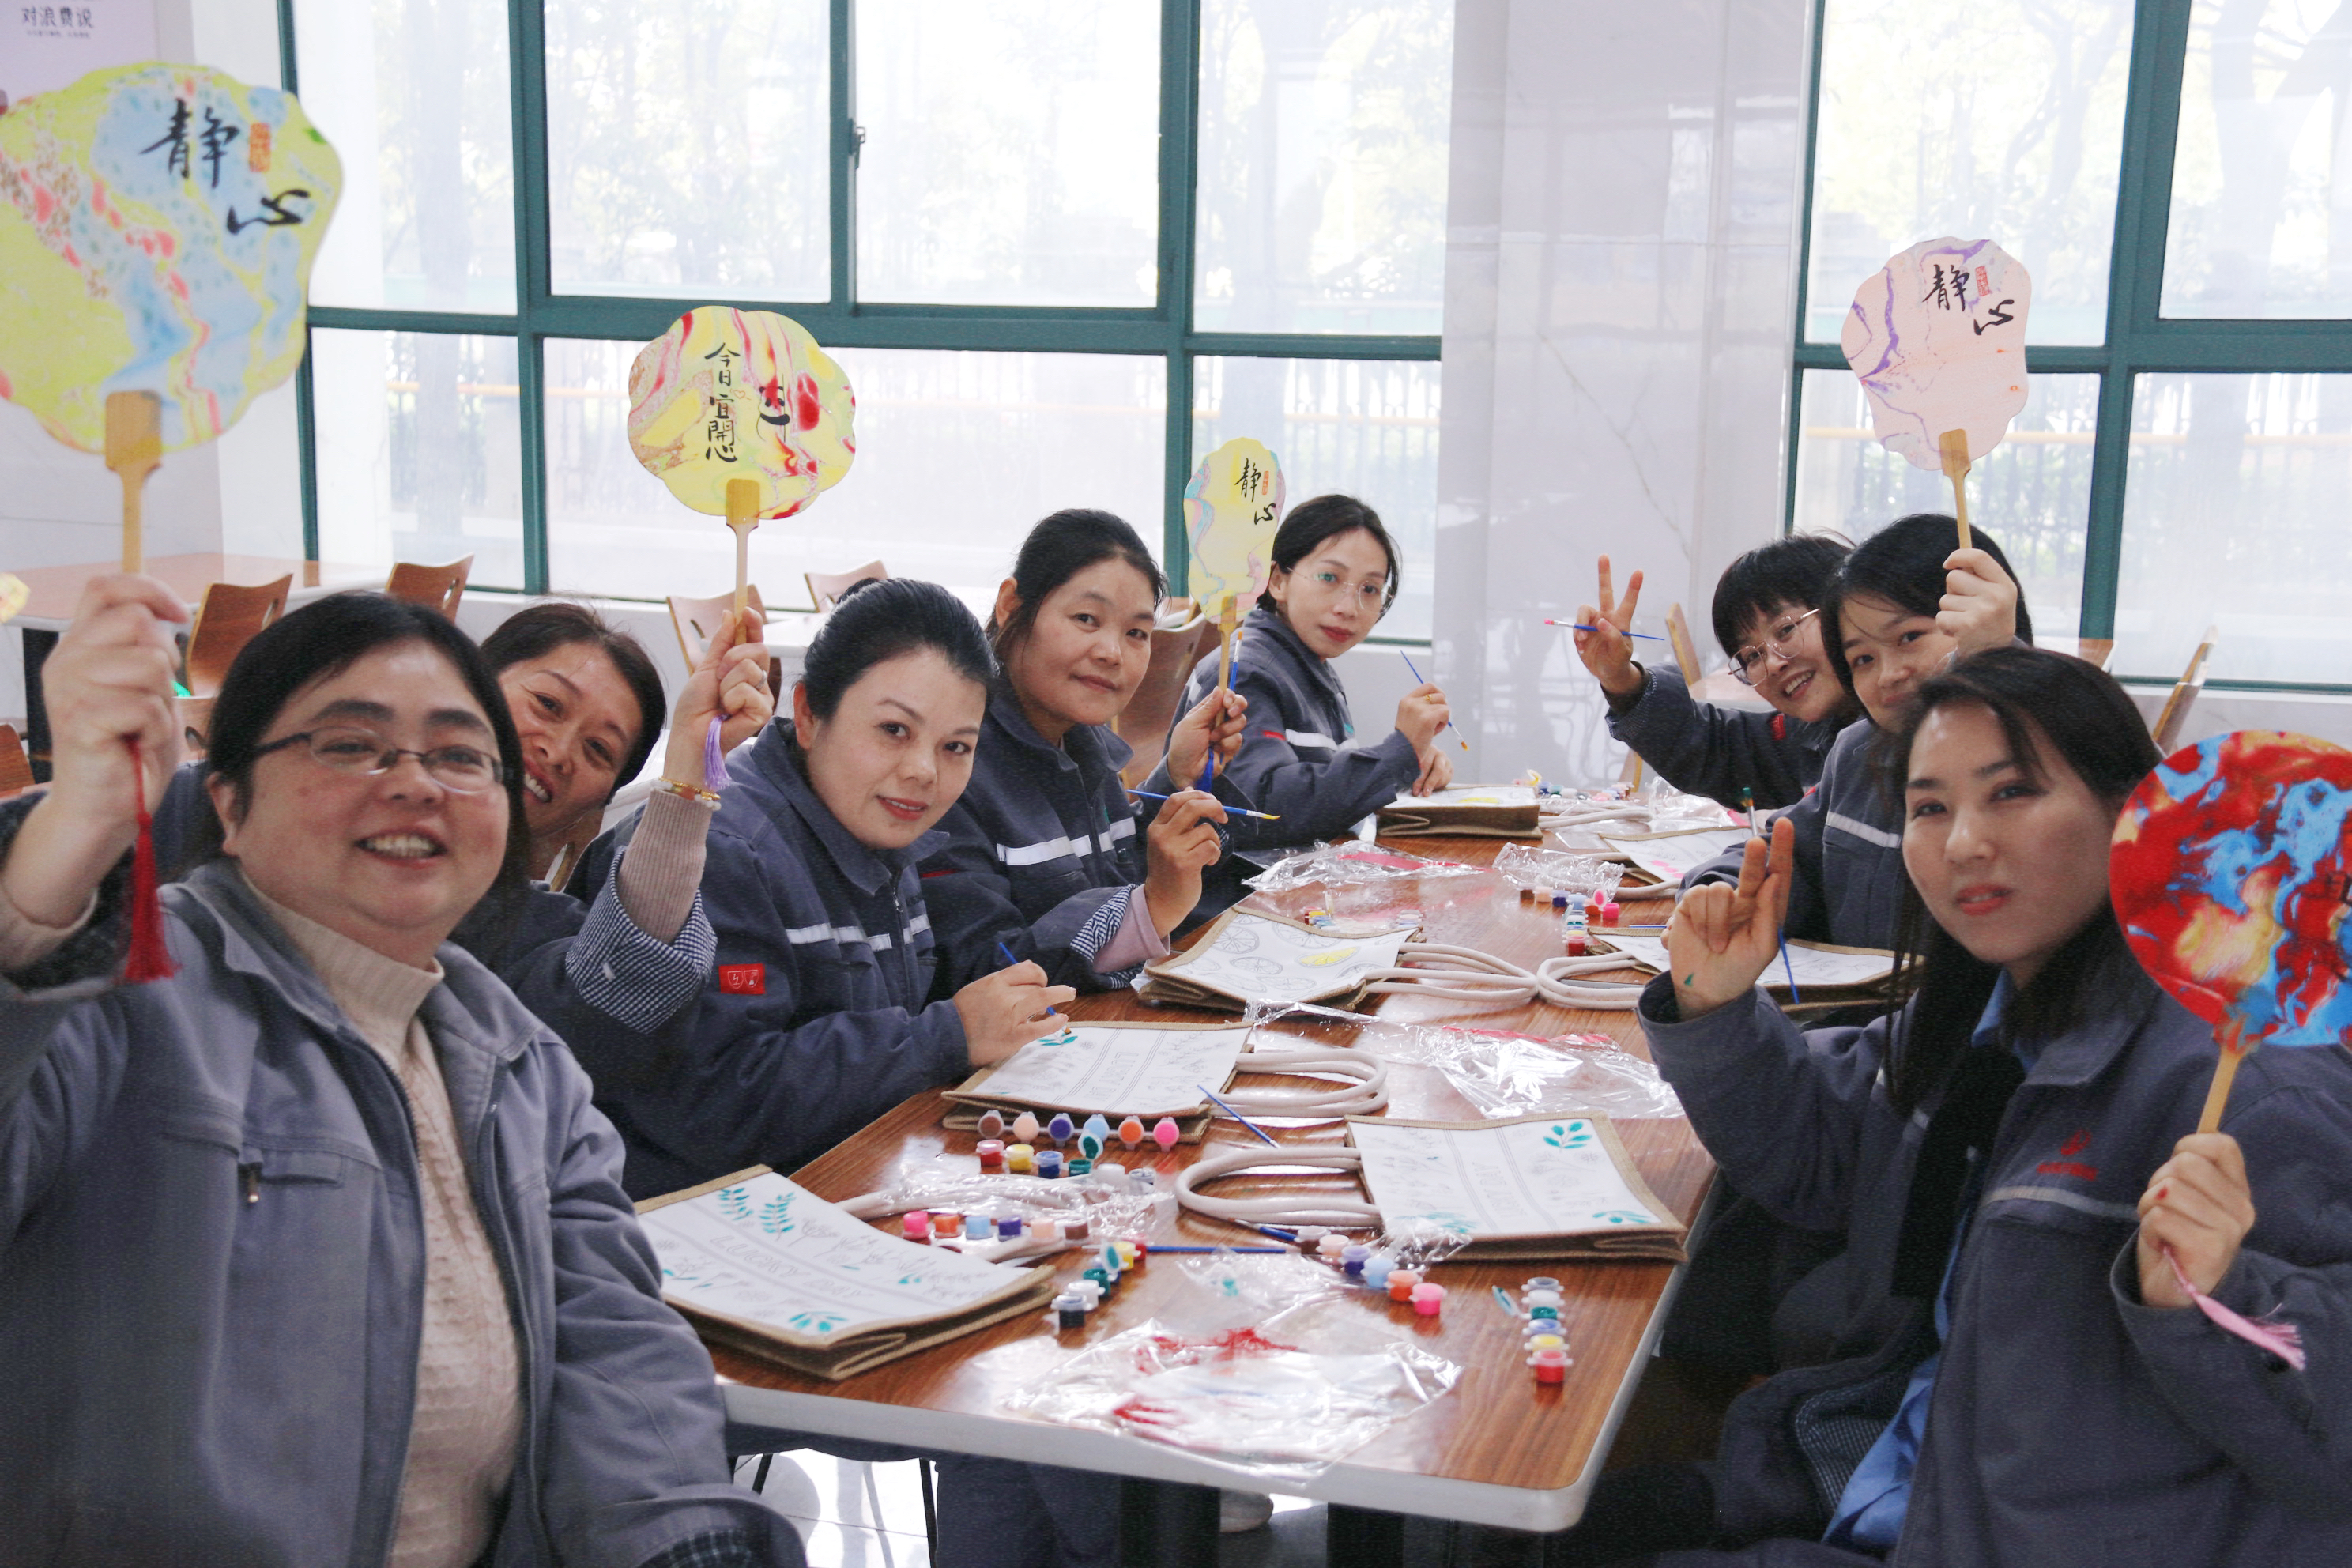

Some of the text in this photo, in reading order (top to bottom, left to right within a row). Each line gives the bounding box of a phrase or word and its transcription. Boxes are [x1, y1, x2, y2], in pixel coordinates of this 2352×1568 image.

[21, 6, 95, 28] 对浪费说
[141, 99, 310, 234] 静心
[1922, 264, 2015, 335] 静心
[1234, 458, 1276, 525] 静心
[710, 1235, 812, 1278] LUCKY
